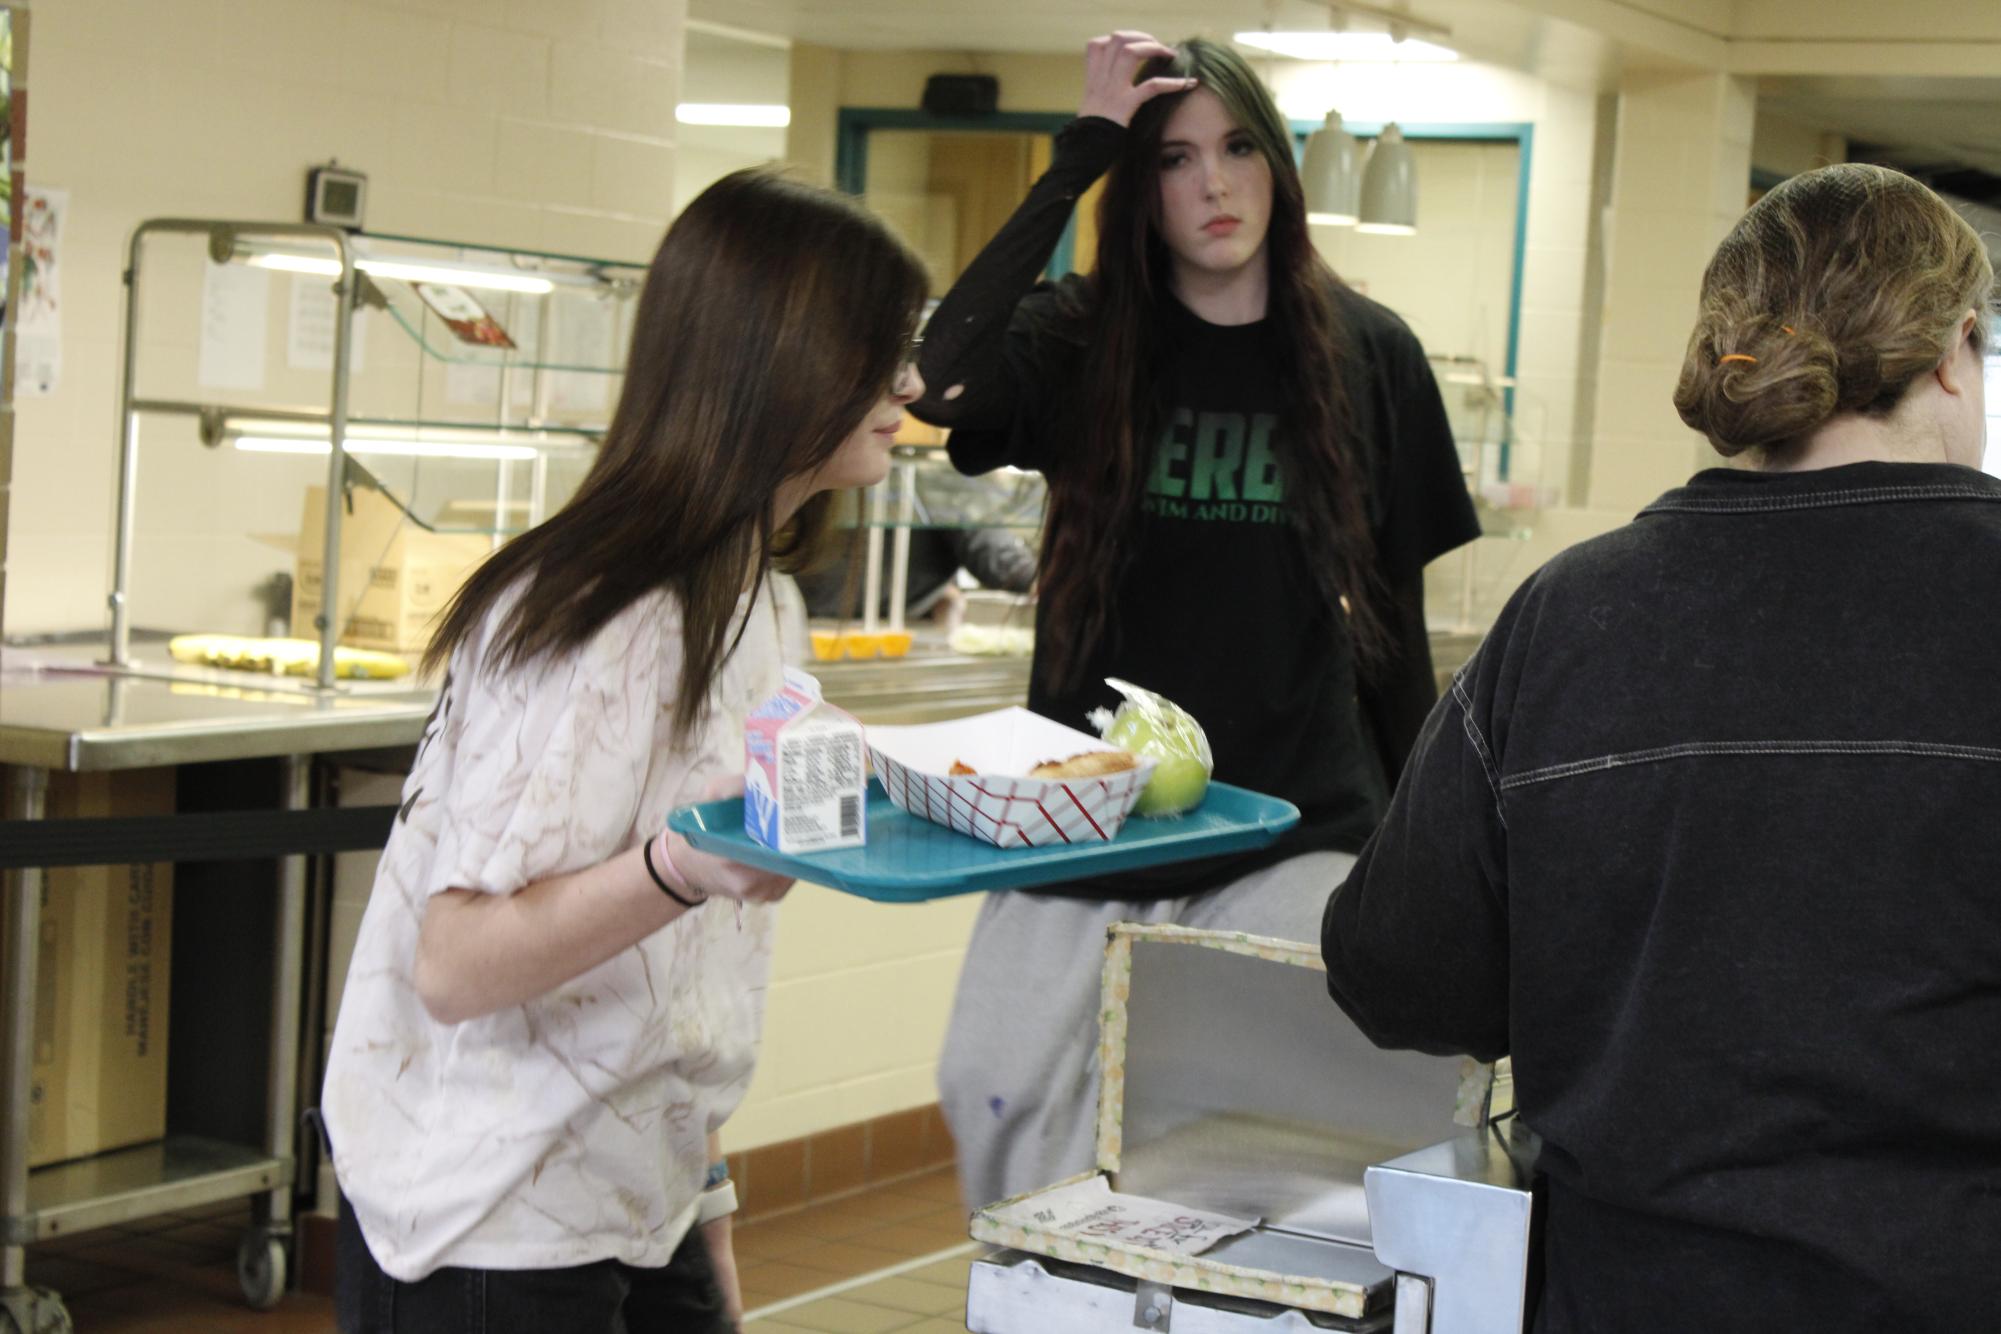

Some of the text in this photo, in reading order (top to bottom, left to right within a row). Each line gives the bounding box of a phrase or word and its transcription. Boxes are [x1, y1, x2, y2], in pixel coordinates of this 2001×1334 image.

[1193, 502, 1247, 522] AND
[1252, 504, 1285, 524] DI
[127, 911, 139, 956] WITH
